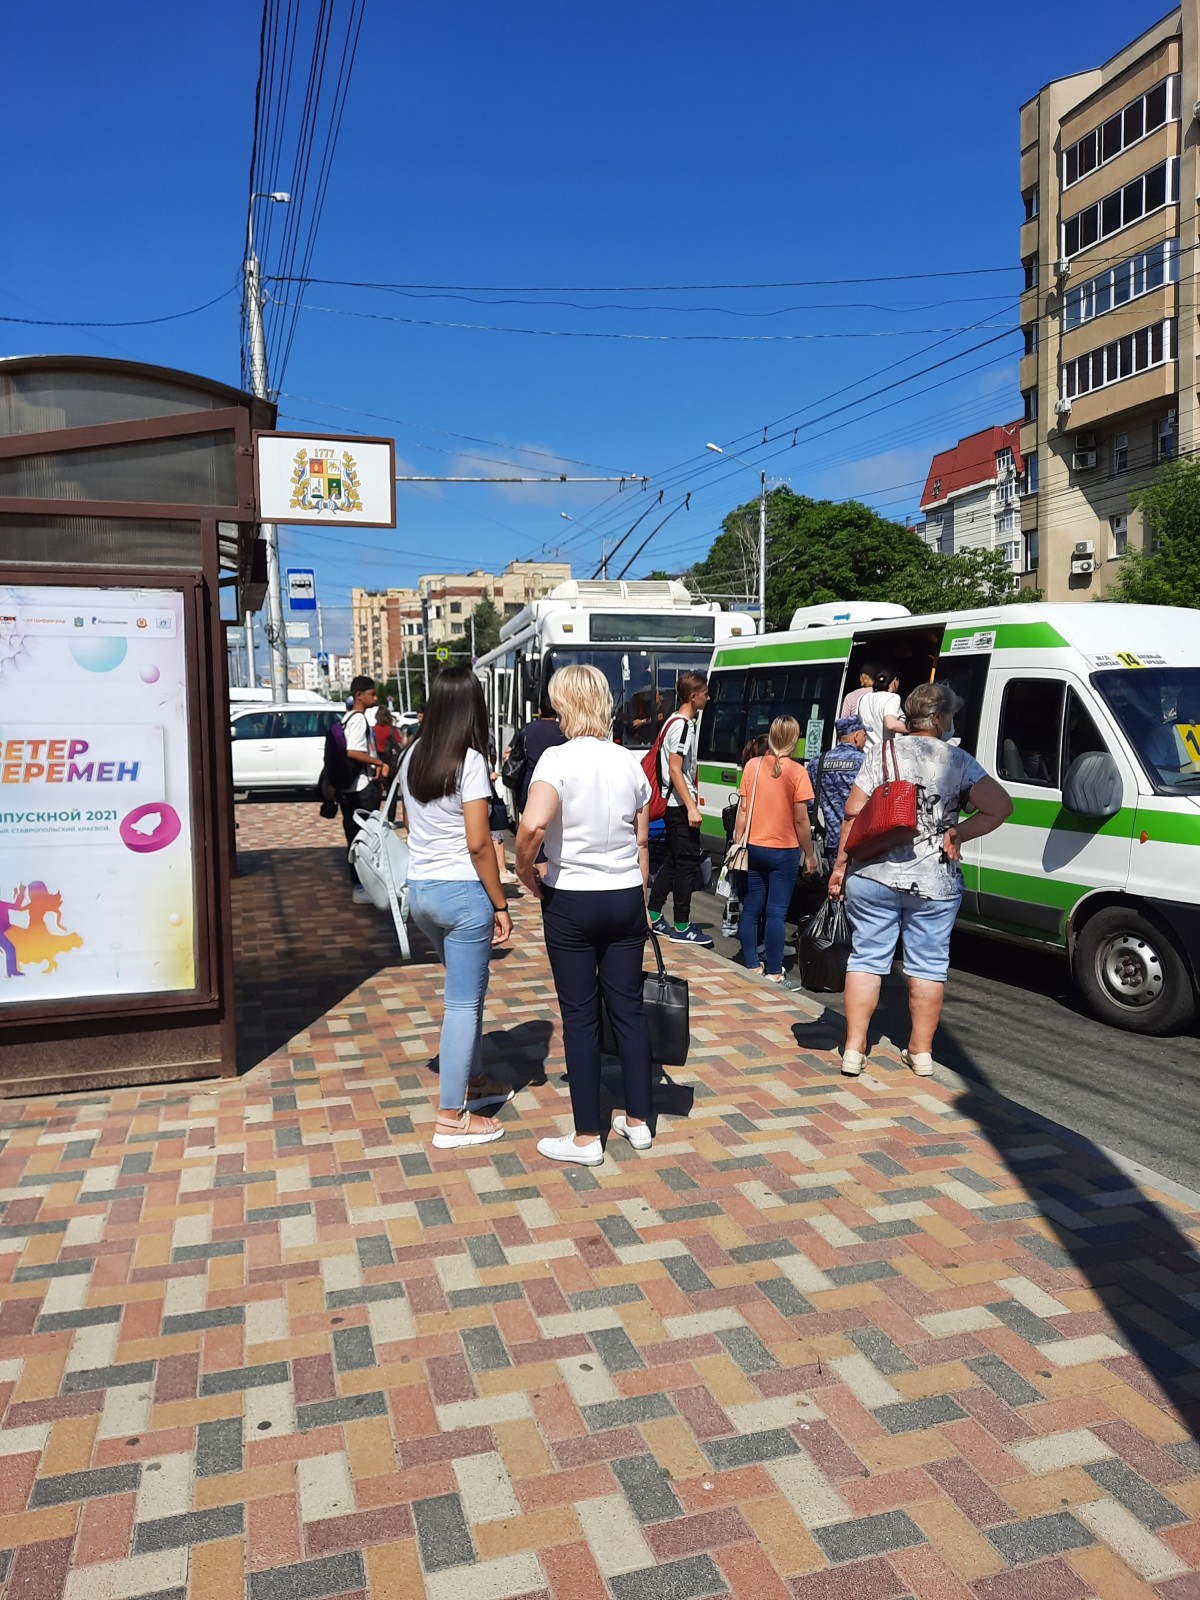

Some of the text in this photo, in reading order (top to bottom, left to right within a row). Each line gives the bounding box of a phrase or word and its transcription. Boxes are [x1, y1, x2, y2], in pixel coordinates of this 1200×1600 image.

[314, 448, 335, 458] 1777
[1117, 653, 1141, 667] 14
[0, 740, 89, 760] ЕТЕР
[0, 762, 139, 783] ЕРЕМЕН
[0, 808, 118, 823] ПУСКНОЙ 2021
